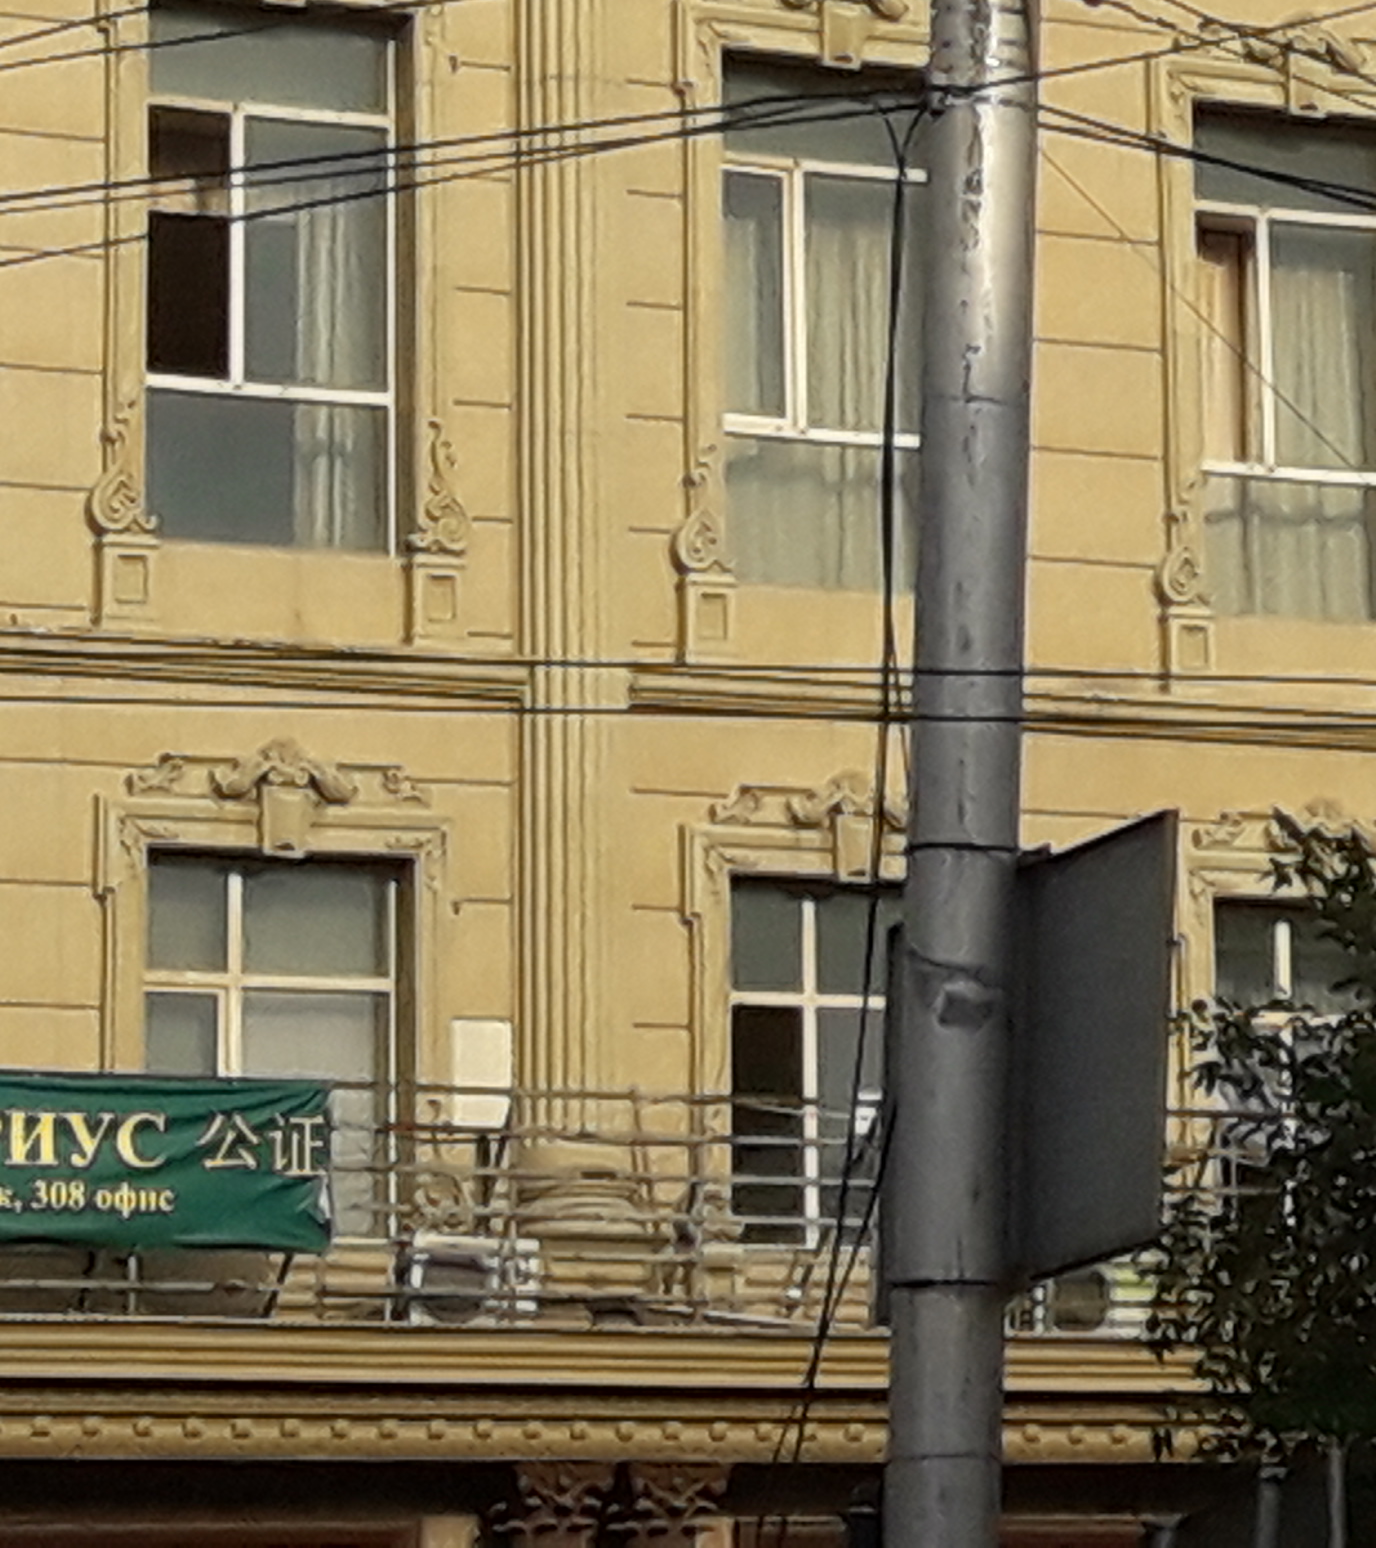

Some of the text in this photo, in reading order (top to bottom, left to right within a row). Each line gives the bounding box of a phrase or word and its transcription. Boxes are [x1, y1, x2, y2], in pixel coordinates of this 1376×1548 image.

[0, 1109, 327, 1177] ИУС 公证
[30, 1179, 86, 1210] 308
[94, 1181, 175, 1220] офис
